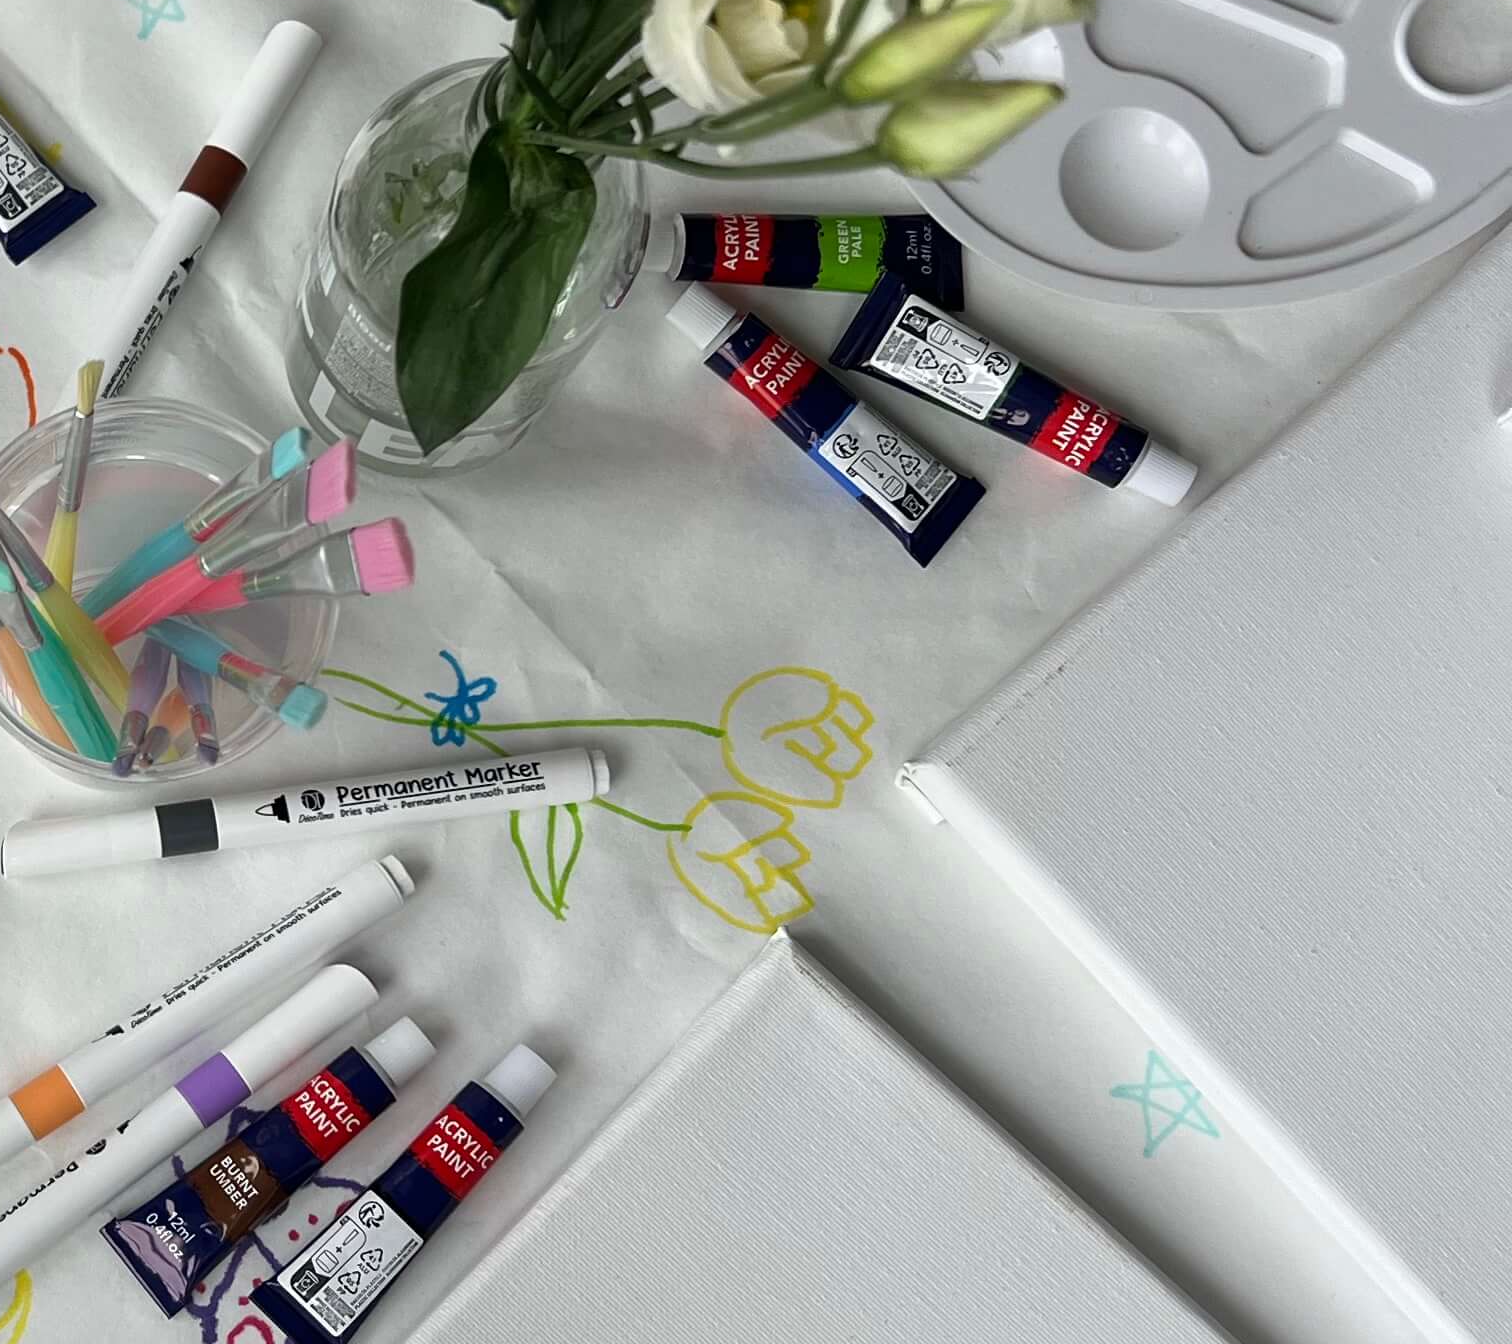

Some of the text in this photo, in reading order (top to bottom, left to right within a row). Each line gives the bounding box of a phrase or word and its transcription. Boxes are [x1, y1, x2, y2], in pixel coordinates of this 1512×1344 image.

[836, 219, 849, 263] GREEN
[850, 226, 862, 257] PALE
[906, 230, 918, 260] 12ml
[1049, 399, 1091, 451] PAINT
[337, 760, 542, 803] Permanent Marker
[340, 807, 362, 817] Dries
[365, 802, 389, 815] quick
[401, 794, 451, 809] Permanent
[455, 793, 466, 801] on
[470, 785, 503, 799] smooth
[507, 781, 546, 795] surfaces
[292, 1090, 338, 1141] PAINT
[424, 1133, 475, 1181] PAINT
[433, 1112, 495, 1170] ACRYLIC
[206, 1163, 249, 1210] UMBER
[218, 1154, 259, 1200] BURNT
[165, 1211, 195, 1244] 12ml
